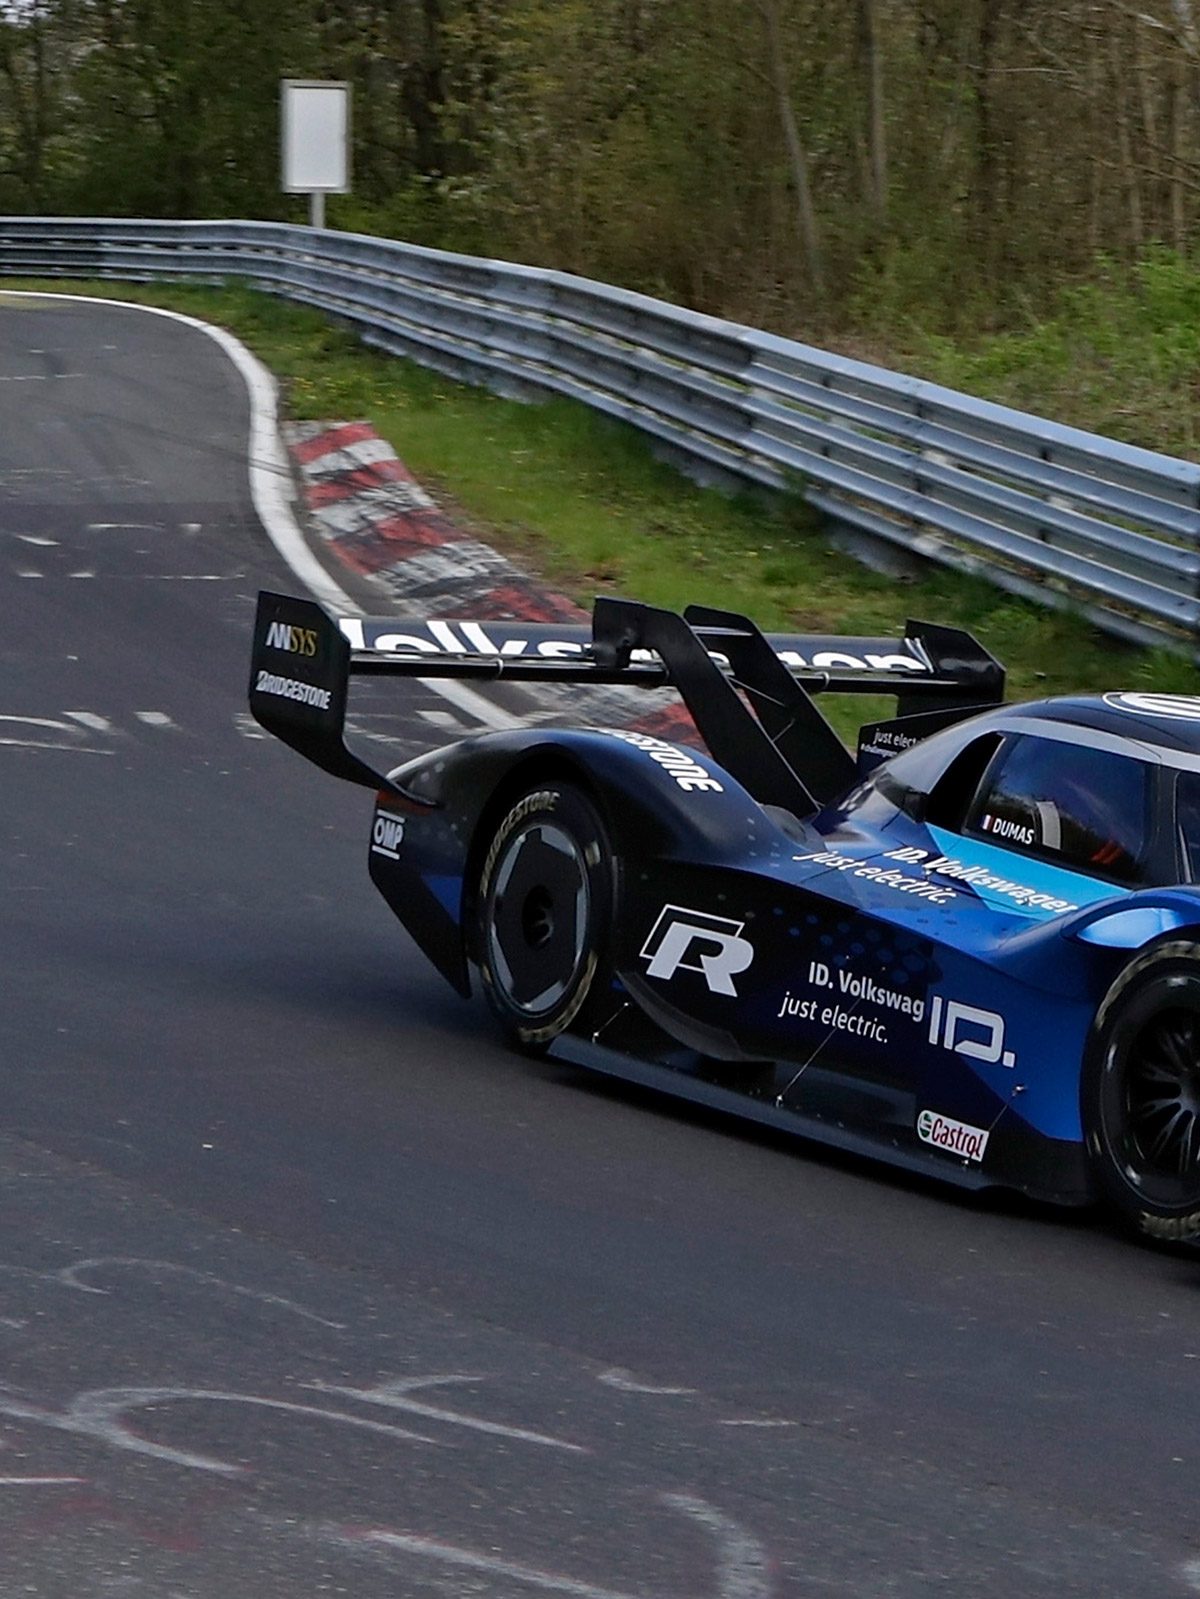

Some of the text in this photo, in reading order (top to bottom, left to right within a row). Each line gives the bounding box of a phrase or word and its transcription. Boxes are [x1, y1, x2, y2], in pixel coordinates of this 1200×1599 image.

[266, 620, 319, 657] ANSYS
[255, 670, 333, 711] BRIDGESTONE
[872, 727, 893, 745] just
[374, 818, 404, 851] OMP
[992, 819, 1035, 845] DUMAS
[792, 850, 866, 871] just
[639, 904, 754, 998] R
[808, 961, 926, 1022] ID. Volkswag
[778, 991, 889, 1044] just electric.
[931, 1117, 985, 1158] Castrol
